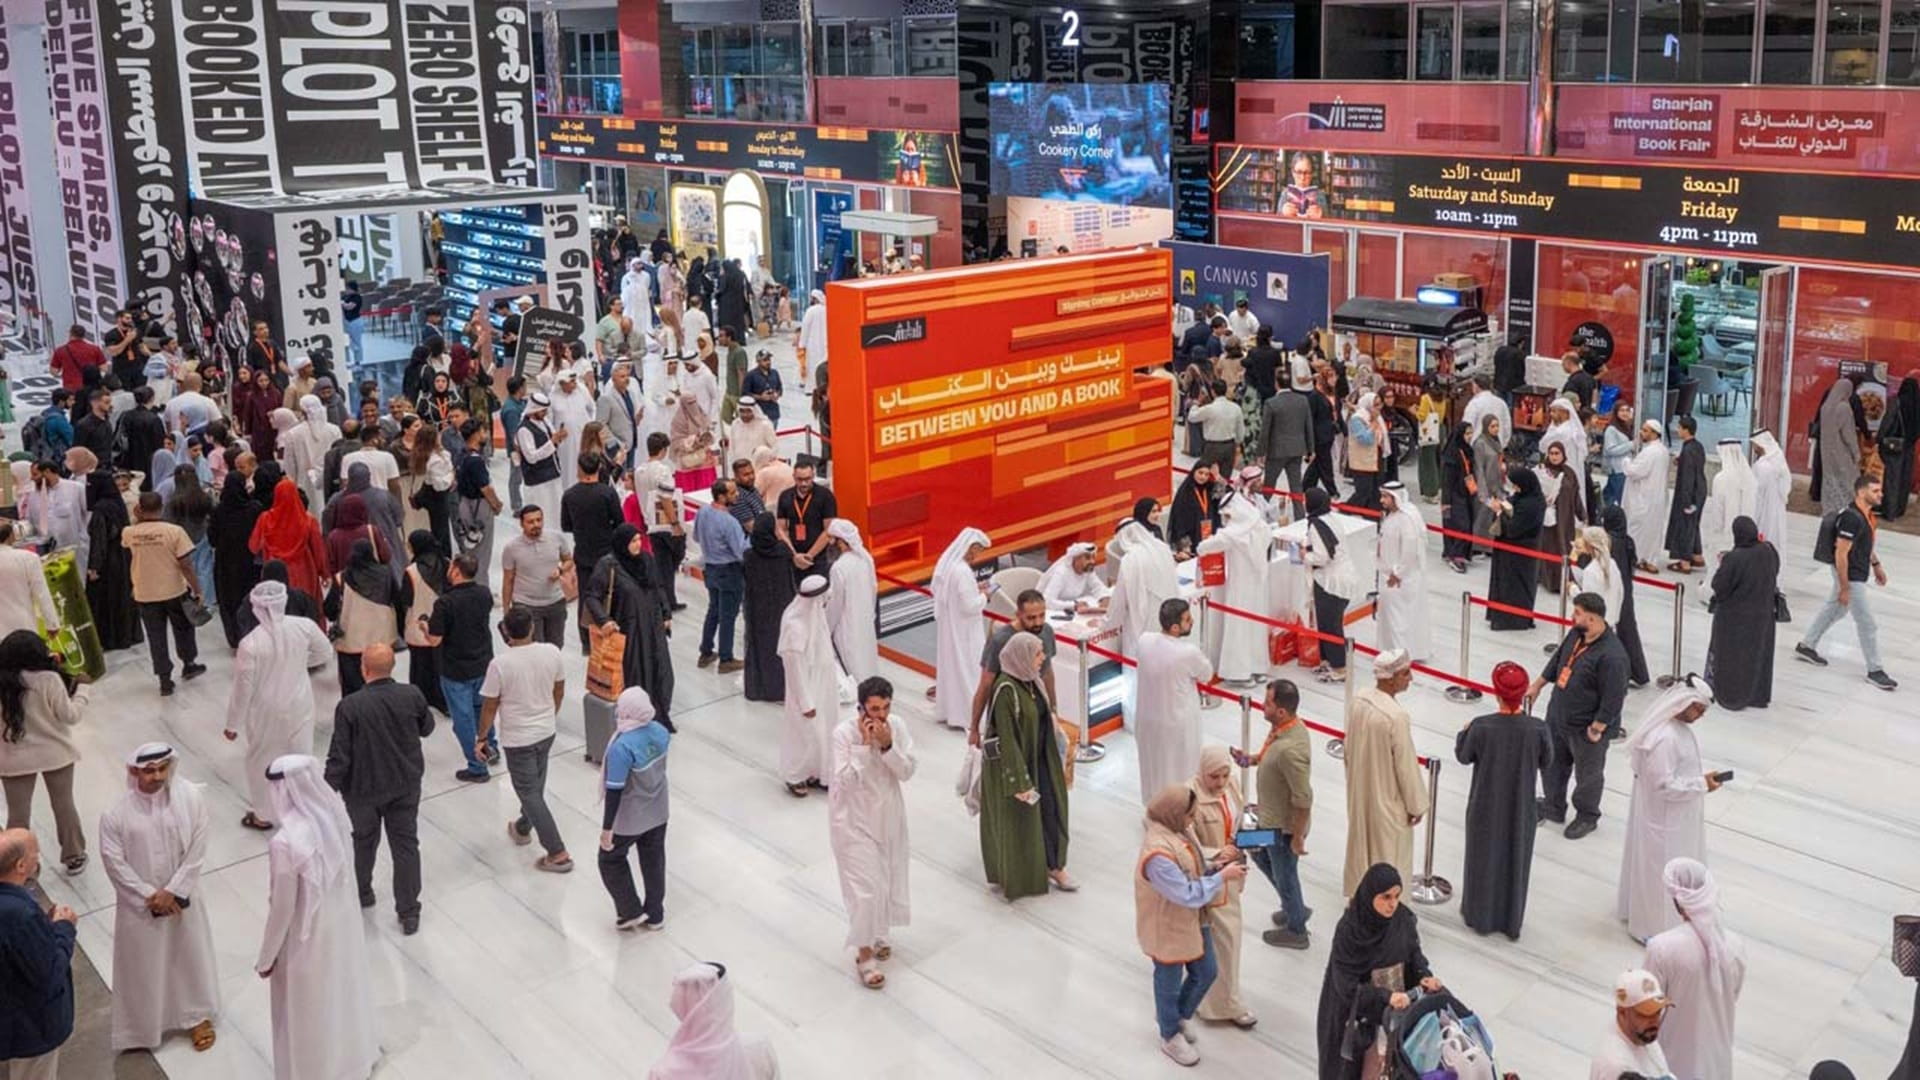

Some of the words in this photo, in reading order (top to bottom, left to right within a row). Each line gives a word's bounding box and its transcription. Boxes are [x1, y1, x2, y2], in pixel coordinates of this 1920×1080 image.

[1062, 10, 1080, 46] 2
[67, 0, 98, 93] FIVE
[406, 4, 475, 79] ZERO
[488, 6, 530, 84] وضع
[181, 0, 266, 143] BOOKED
[277, 1, 400, 130] PLOT
[1652, 97, 1713, 112] Sharjah
[115, 57, 173, 177] السطور
[412, 85, 486, 171] SHELF
[1613, 117, 1712, 131] International
[1739, 110, 1814, 129] الشارقة
[1816, 118, 1873, 132] معرض
[1039, 142, 1078, 158] Cookery
[1079, 144, 1114, 158] Corner
[1639, 137, 1677, 150] Book
[1679, 138, 1711, 151] Fair
[1738, 135, 1797, 151] للكتاب
[1800, 138, 1848, 156] الدولي
[1481, 167, 1521, 185] السبت
[1683, 176, 1740, 197] الجمعة
[1409, 184, 1468, 205] Saturday
[1471, 187, 1498, 202] and
[1500, 188, 1555, 211] Sunday
[1435, 208, 1473, 223] 10am
[1482, 213, 1518, 228] 11pm
[1681, 201, 1738, 224] Friday
[1659, 225, 1699, 242] 4pm
[1713, 230, 1759, 247] 11pm
[61, 178, 93, 326] BELULU
[1203, 264, 1258, 288] CANVAS
[1578, 326, 1595, 337] the
[1060, 348, 1121, 375] بينك
[996, 361, 1057, 390] وبين
[879, 368, 992, 413] الكتاب
[880, 407, 977, 447] BETWEEN
[979, 399, 1017, 424] YOU
[1019, 391, 1058, 416] AND
[1061, 388, 1073, 407] A
[1076, 377, 1121, 404] BOOK
